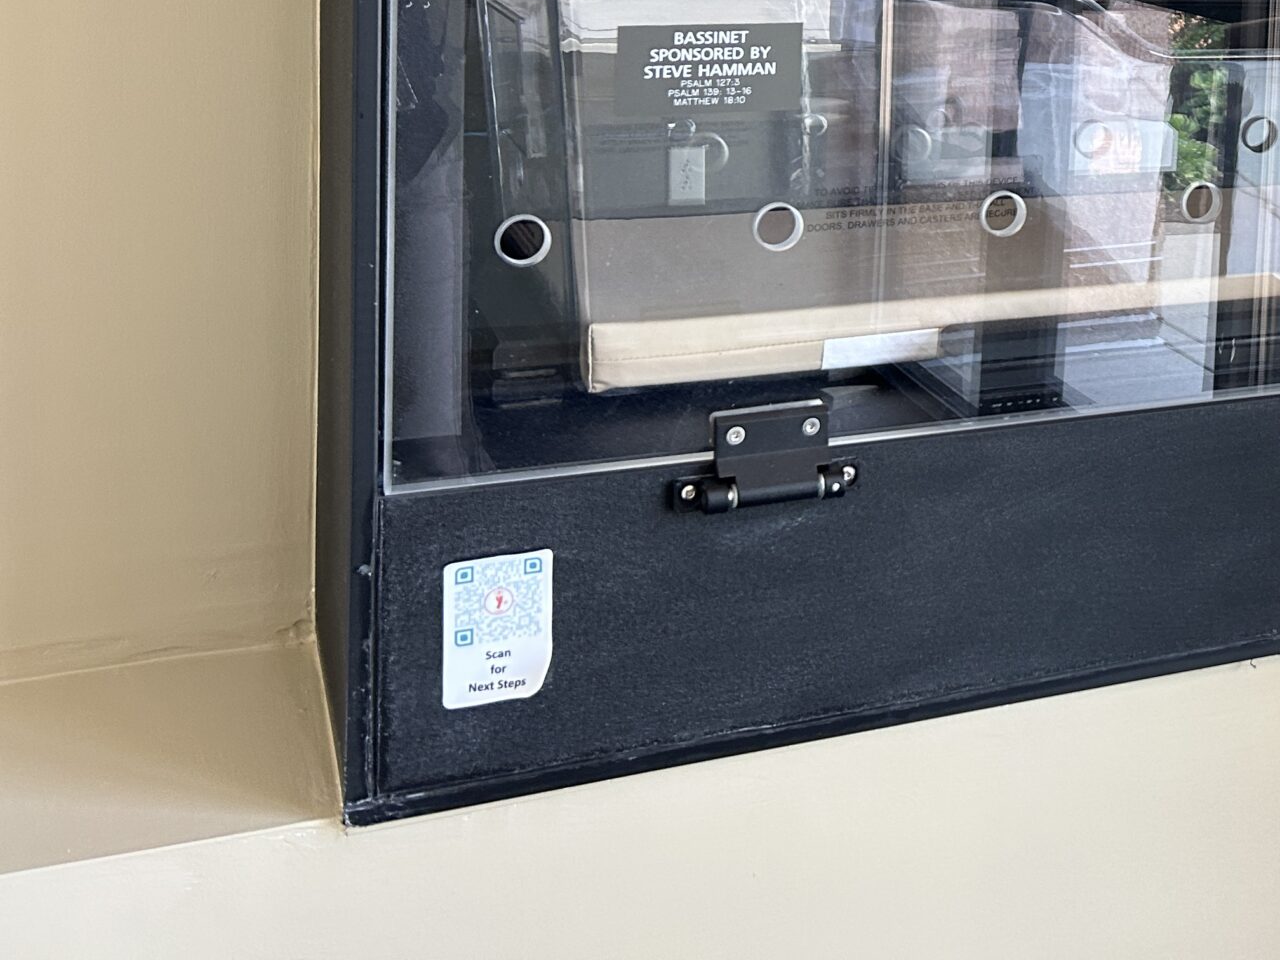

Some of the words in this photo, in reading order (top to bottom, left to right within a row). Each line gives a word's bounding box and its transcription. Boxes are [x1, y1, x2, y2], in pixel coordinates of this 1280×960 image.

[674, 30, 749, 45] BASSINET
[649, 47, 744, 62] SPONSORED
[751, 46, 772, 59] BY
[643, 64, 692, 79] STEVE
[698, 62, 777, 77] HAMMAN
[680, 79, 712, 88] PSALM
[716, 79, 740, 87] 127:3
[667, 89, 699, 98] PSALM
[703, 88, 722, 96] 139:
[726, 87, 752, 95] 13-16
[673, 97, 719, 106] MATTHEW
[723, 96, 746, 105] 18:10
[826, 210, 847, 219] SITS
[886, 207, 896, 216] IN
[898, 216, 917, 225] AND
[485, 649, 511, 660] Scan
[490, 664, 507, 674] for
[469, 682, 494, 693] Next
[497, 678, 526, 690] Steps
